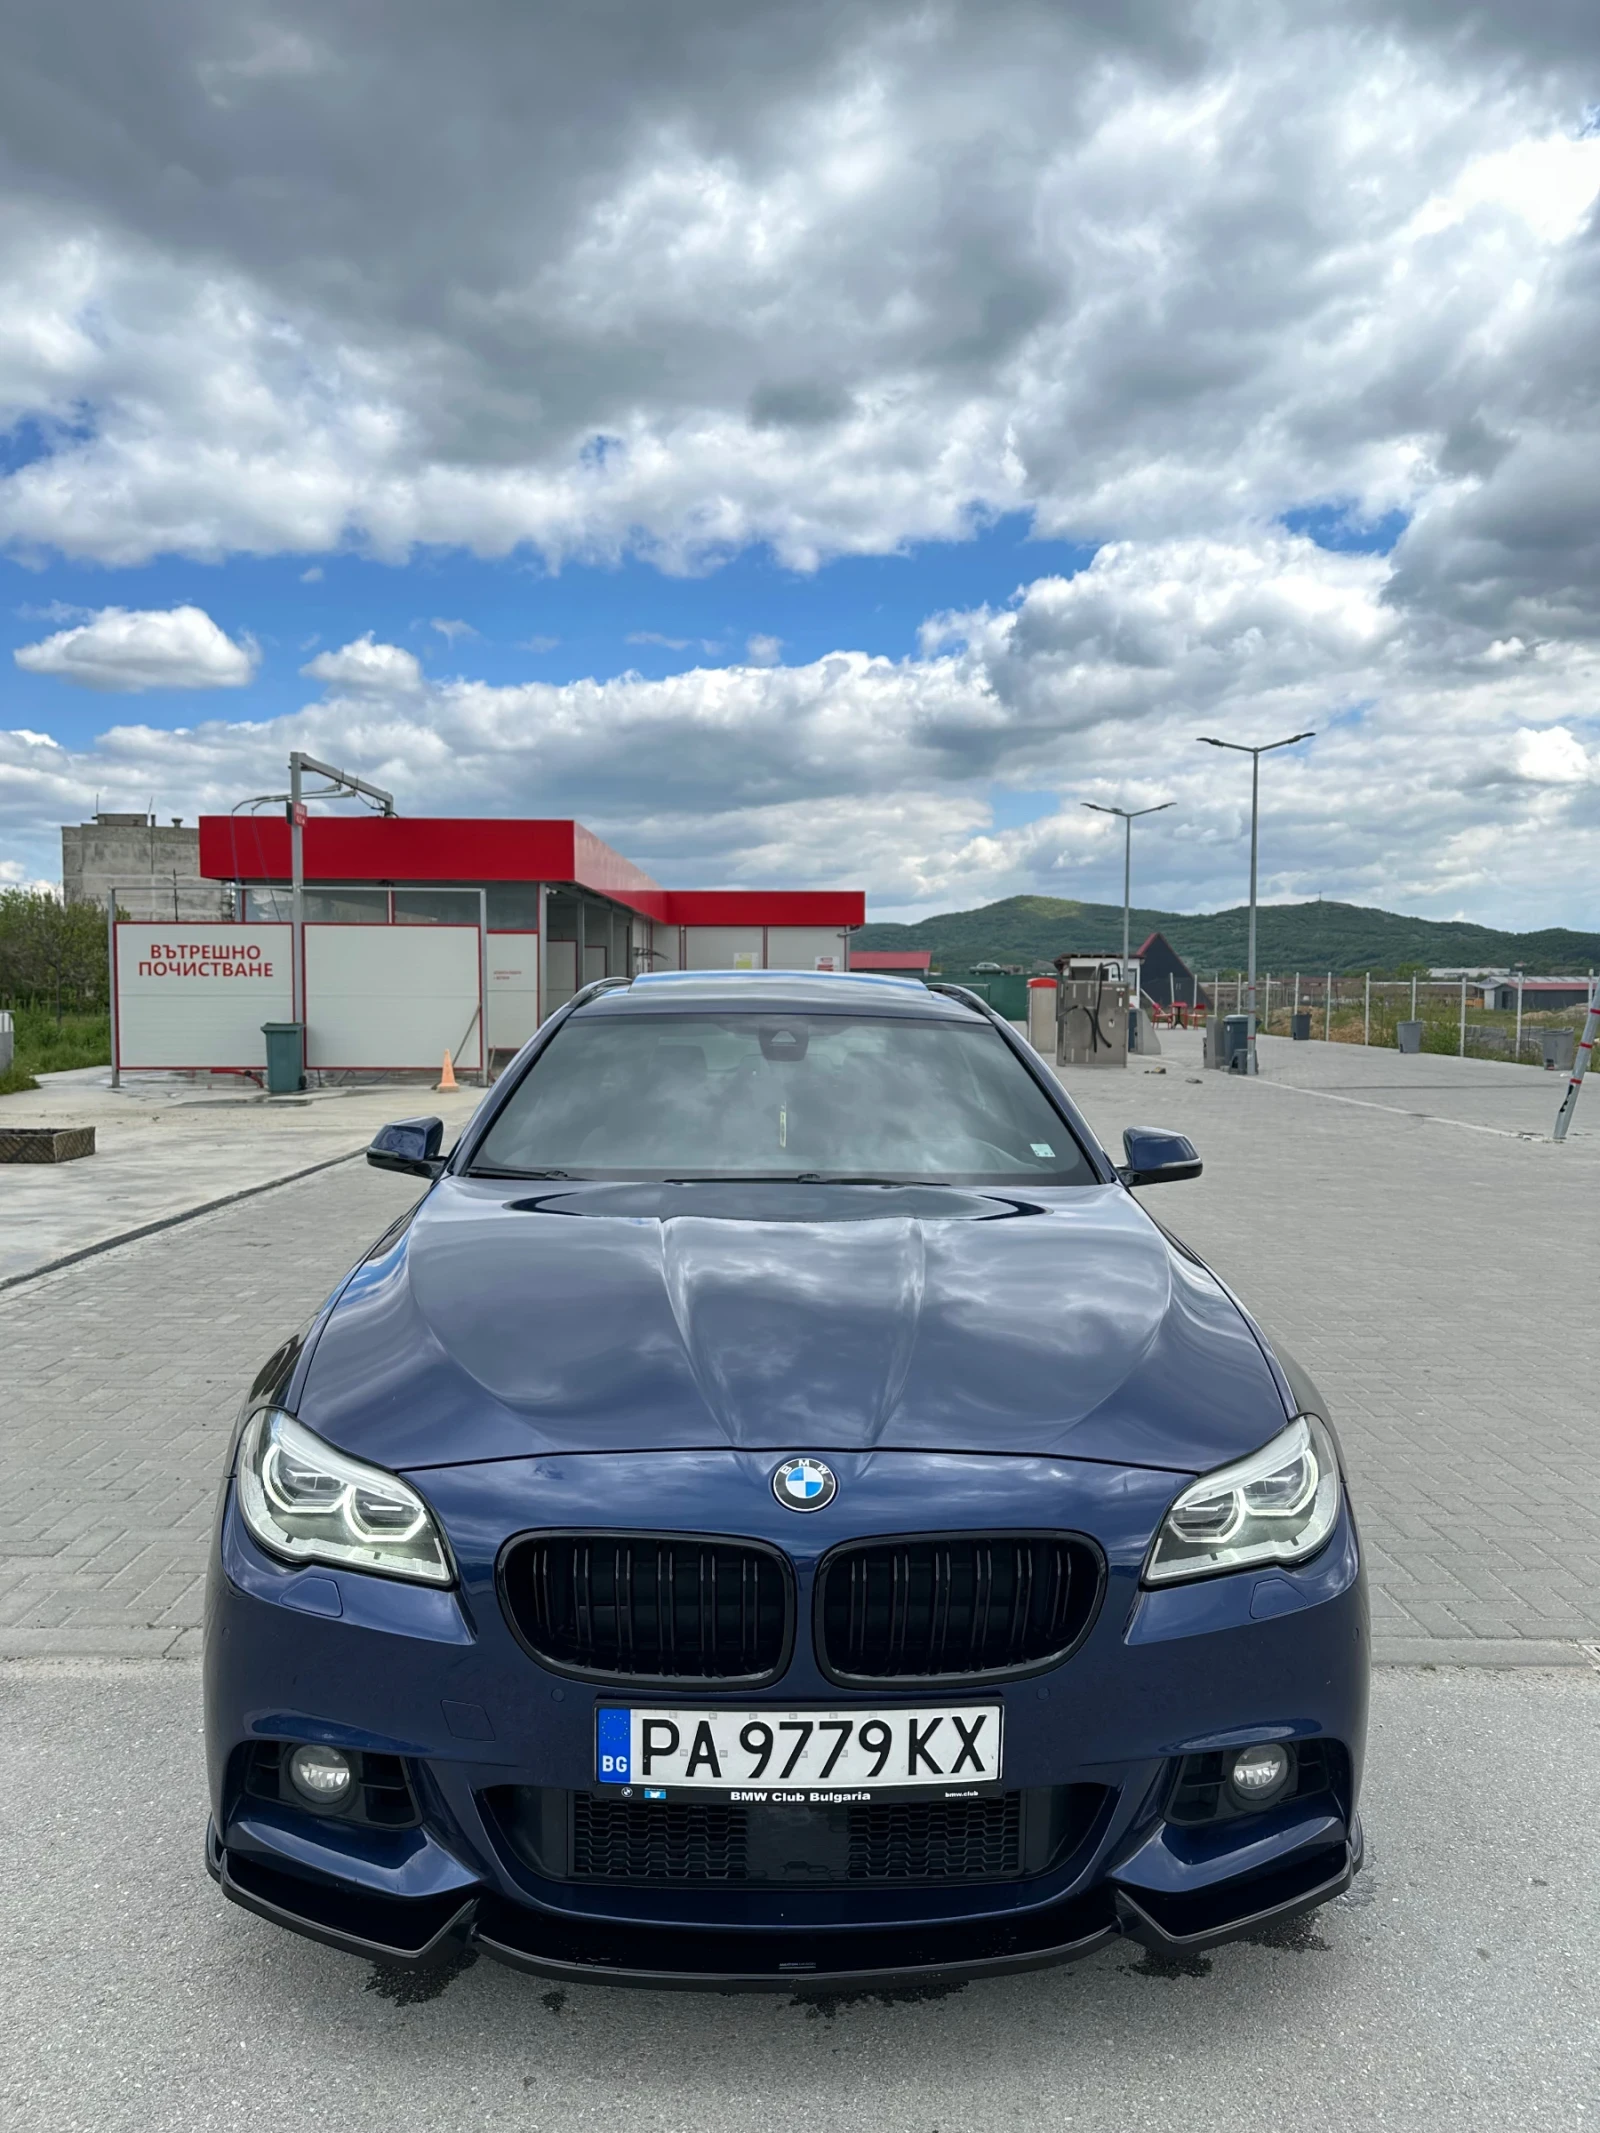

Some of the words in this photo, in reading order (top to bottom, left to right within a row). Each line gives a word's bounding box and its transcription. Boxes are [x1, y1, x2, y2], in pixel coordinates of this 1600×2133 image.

[150, 944, 262, 960] ВЪТРЕШНО
[138, 961, 274, 977] ПОЧИСТВАНЕ
[779, 1458, 831, 1475] BMW
[602, 1755, 628, 1773] BG
[730, 1791, 768, 1802] BMW
[771, 1792, 806, 1802] Club
[809, 1791, 871, 1803] Bulgaria
